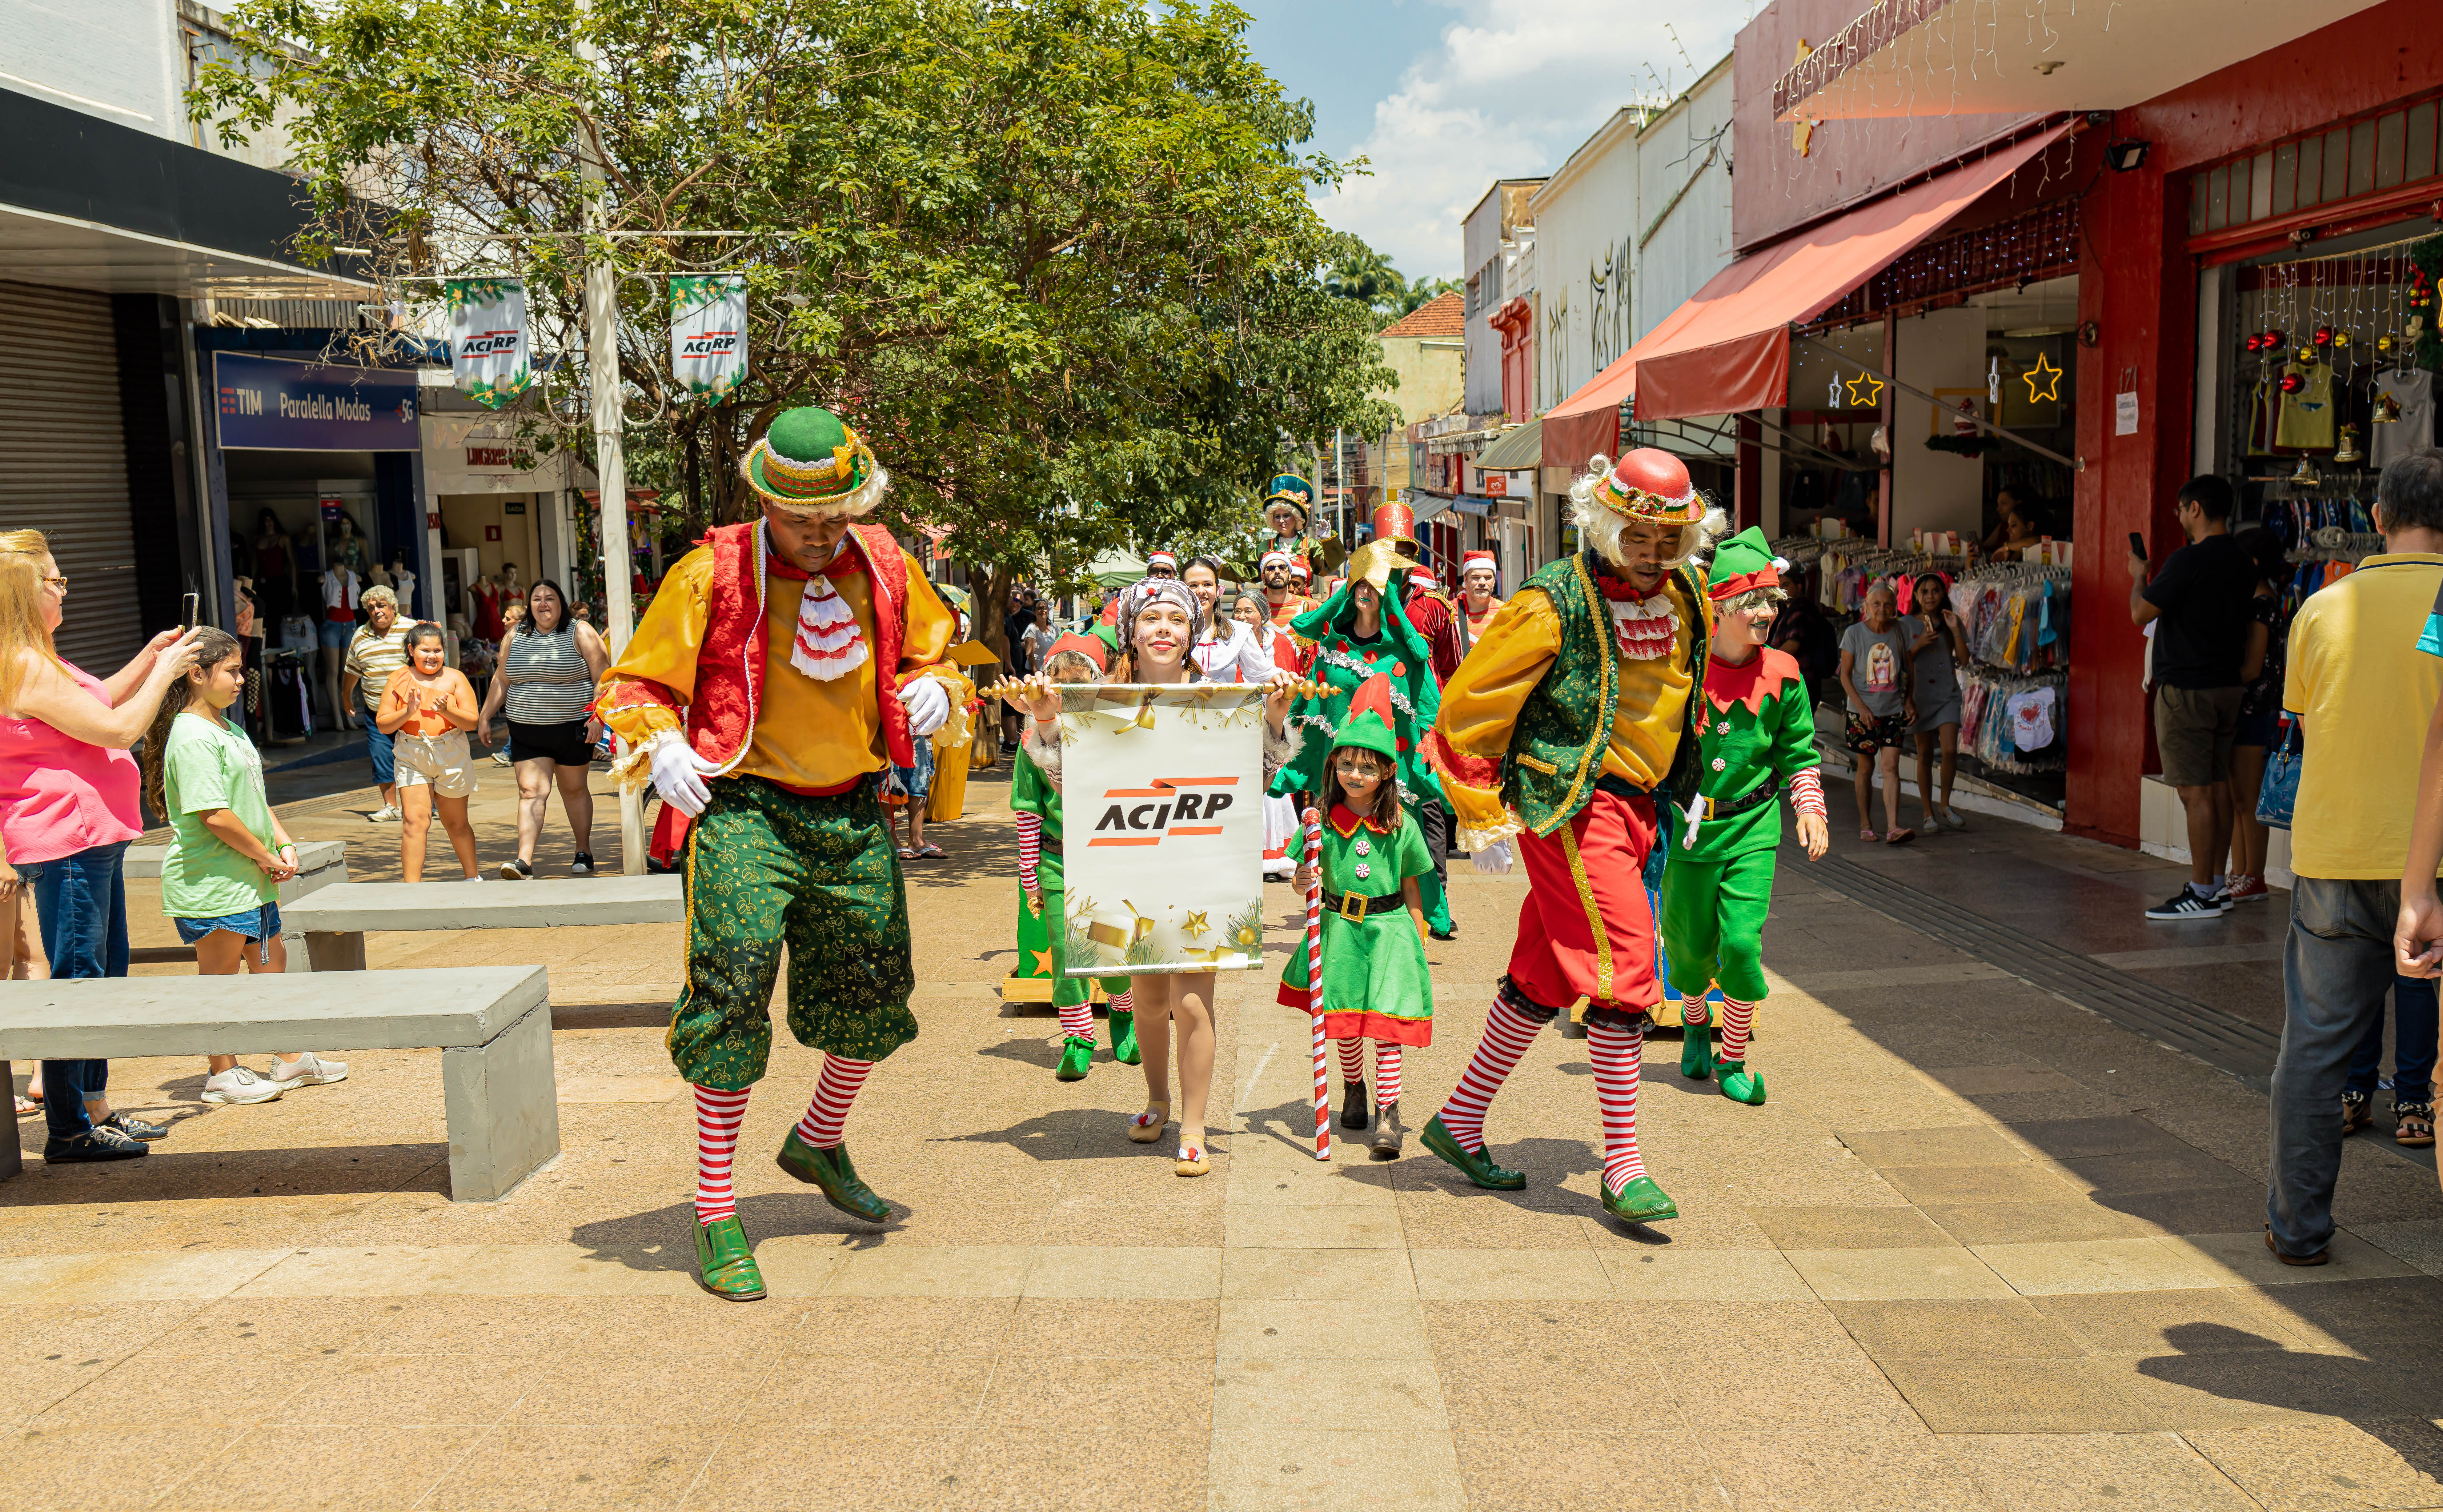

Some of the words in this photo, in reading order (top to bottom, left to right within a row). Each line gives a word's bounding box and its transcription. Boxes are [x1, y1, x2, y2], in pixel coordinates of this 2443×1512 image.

[463, 336, 517, 352] ACIRP
[683, 338, 736, 352] ACIRP
[2119, 366, 2137, 393] 171
[237, 389, 262, 416] TIM
[280, 392, 333, 420] Paralella
[336, 396, 371, 422] Modas
[402, 399, 413, 423] 5G
[1095, 793, 1233, 830] ACIRP
